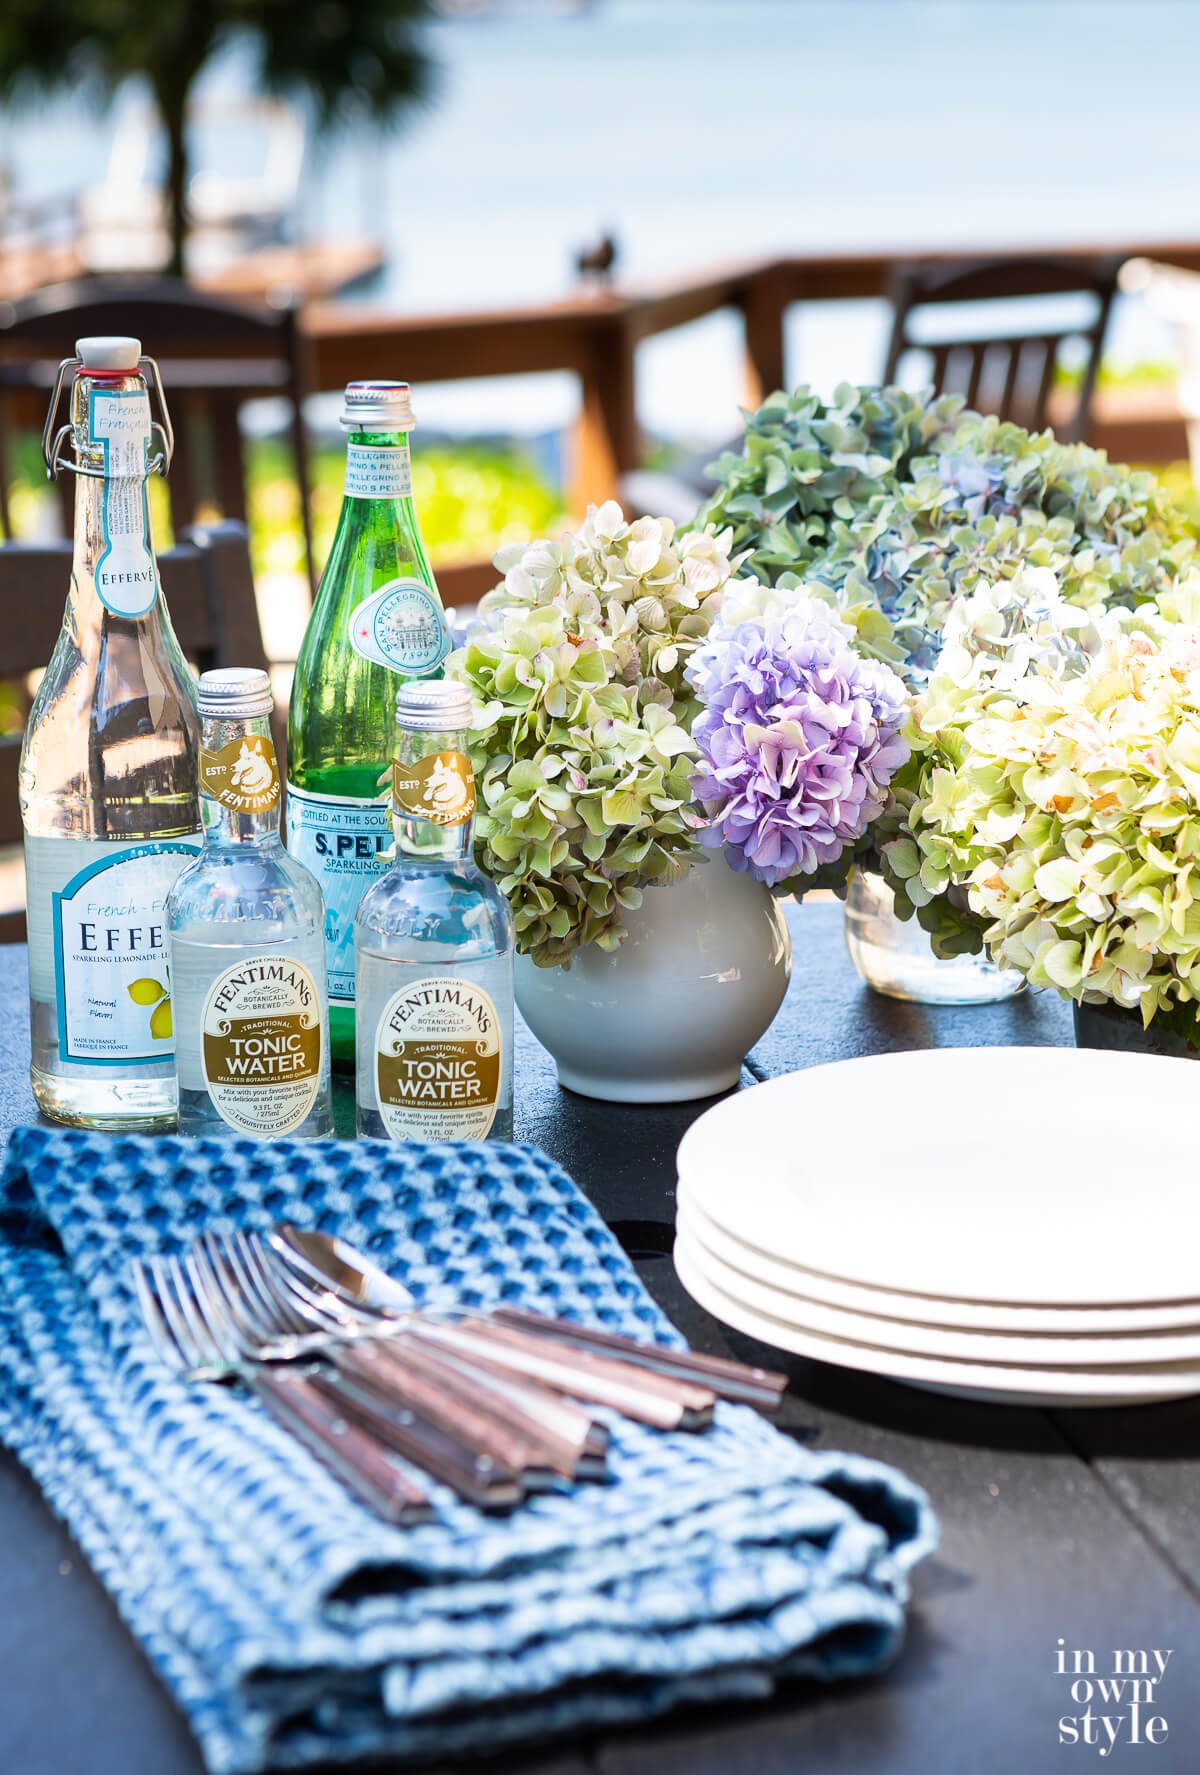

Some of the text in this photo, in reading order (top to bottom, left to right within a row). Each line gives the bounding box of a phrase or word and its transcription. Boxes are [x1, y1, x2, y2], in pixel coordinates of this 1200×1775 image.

[370, 463, 377, 471] S
[370, 484, 377, 492] S
[377, 593, 430, 625] PELLEGRINO
[379, 629, 393, 652] SAN
[219, 781, 281, 809] FENTIMANS
[410, 799, 475, 823] TIMANS
[331, 815, 342, 824] AT
[344, 815, 361, 825] THE
[364, 816, 388, 826] SOU
[326, 859, 380, 870] SPARKLING
[87, 897, 136, 917] French
[79, 922, 163, 951] EFFE
[72, 953, 112, 963] SPARKLING
[114, 953, 156, 963] LEMONADE
[213, 965, 312, 1014] FENTIMANS
[87, 997, 117, 1008] Natural
[243, 993, 288, 1003] BOTANICALLY
[252, 1002, 281, 1010] BREWED
[389, 989, 492, 1034] FENTIMANS
[89, 1009, 113, 1019] Flavors
[241, 1020, 291, 1032] TRADITIONAL
[229, 1034, 302, 1056] TONIC
[415, 1044, 466, 1054] TRADITIONAL
[225, 1052, 306, 1075] WATER
[402, 1060, 477, 1080] TONIC
[217, 1075, 245, 1083] SELECTED
[268, 1086, 292, 1095] favorite
[397, 1079, 481, 1099] WATER
[274, 1092, 294, 1101] unique
[389, 1097, 416, 1106] SELECTED
[234, 1109, 301, 1130] EXQUISITELY CRAFTED
[440, 1112, 464, 1120] favorite
[403, 1118, 430, 1127] delicious
[444, 1120, 466, 1128] unique
